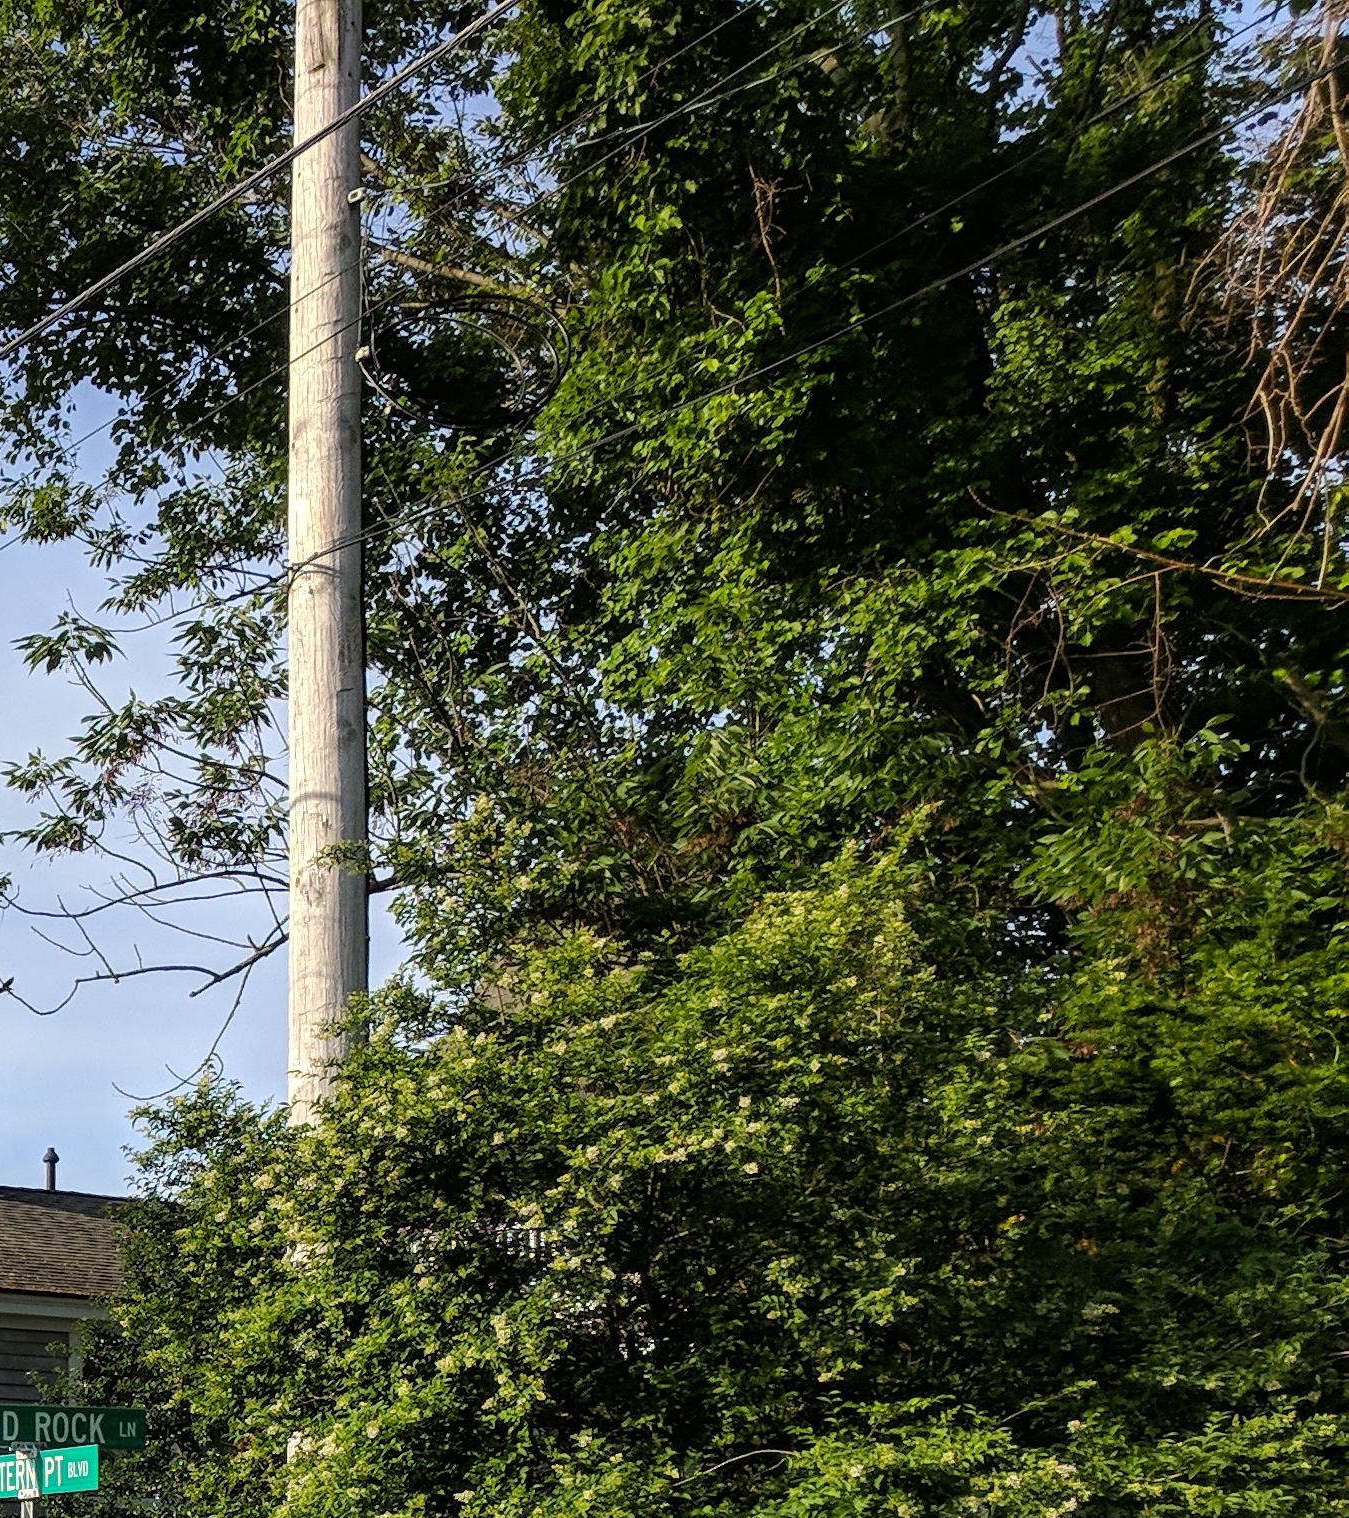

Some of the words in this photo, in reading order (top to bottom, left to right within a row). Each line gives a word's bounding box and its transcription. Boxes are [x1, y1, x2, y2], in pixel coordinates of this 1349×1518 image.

[35, 1411, 106, 1444] ROCK
[119, 1421, 137, 1438] LN
[44, 1455, 63, 1488] PT
[68, 1460, 89, 1478] BLVD
